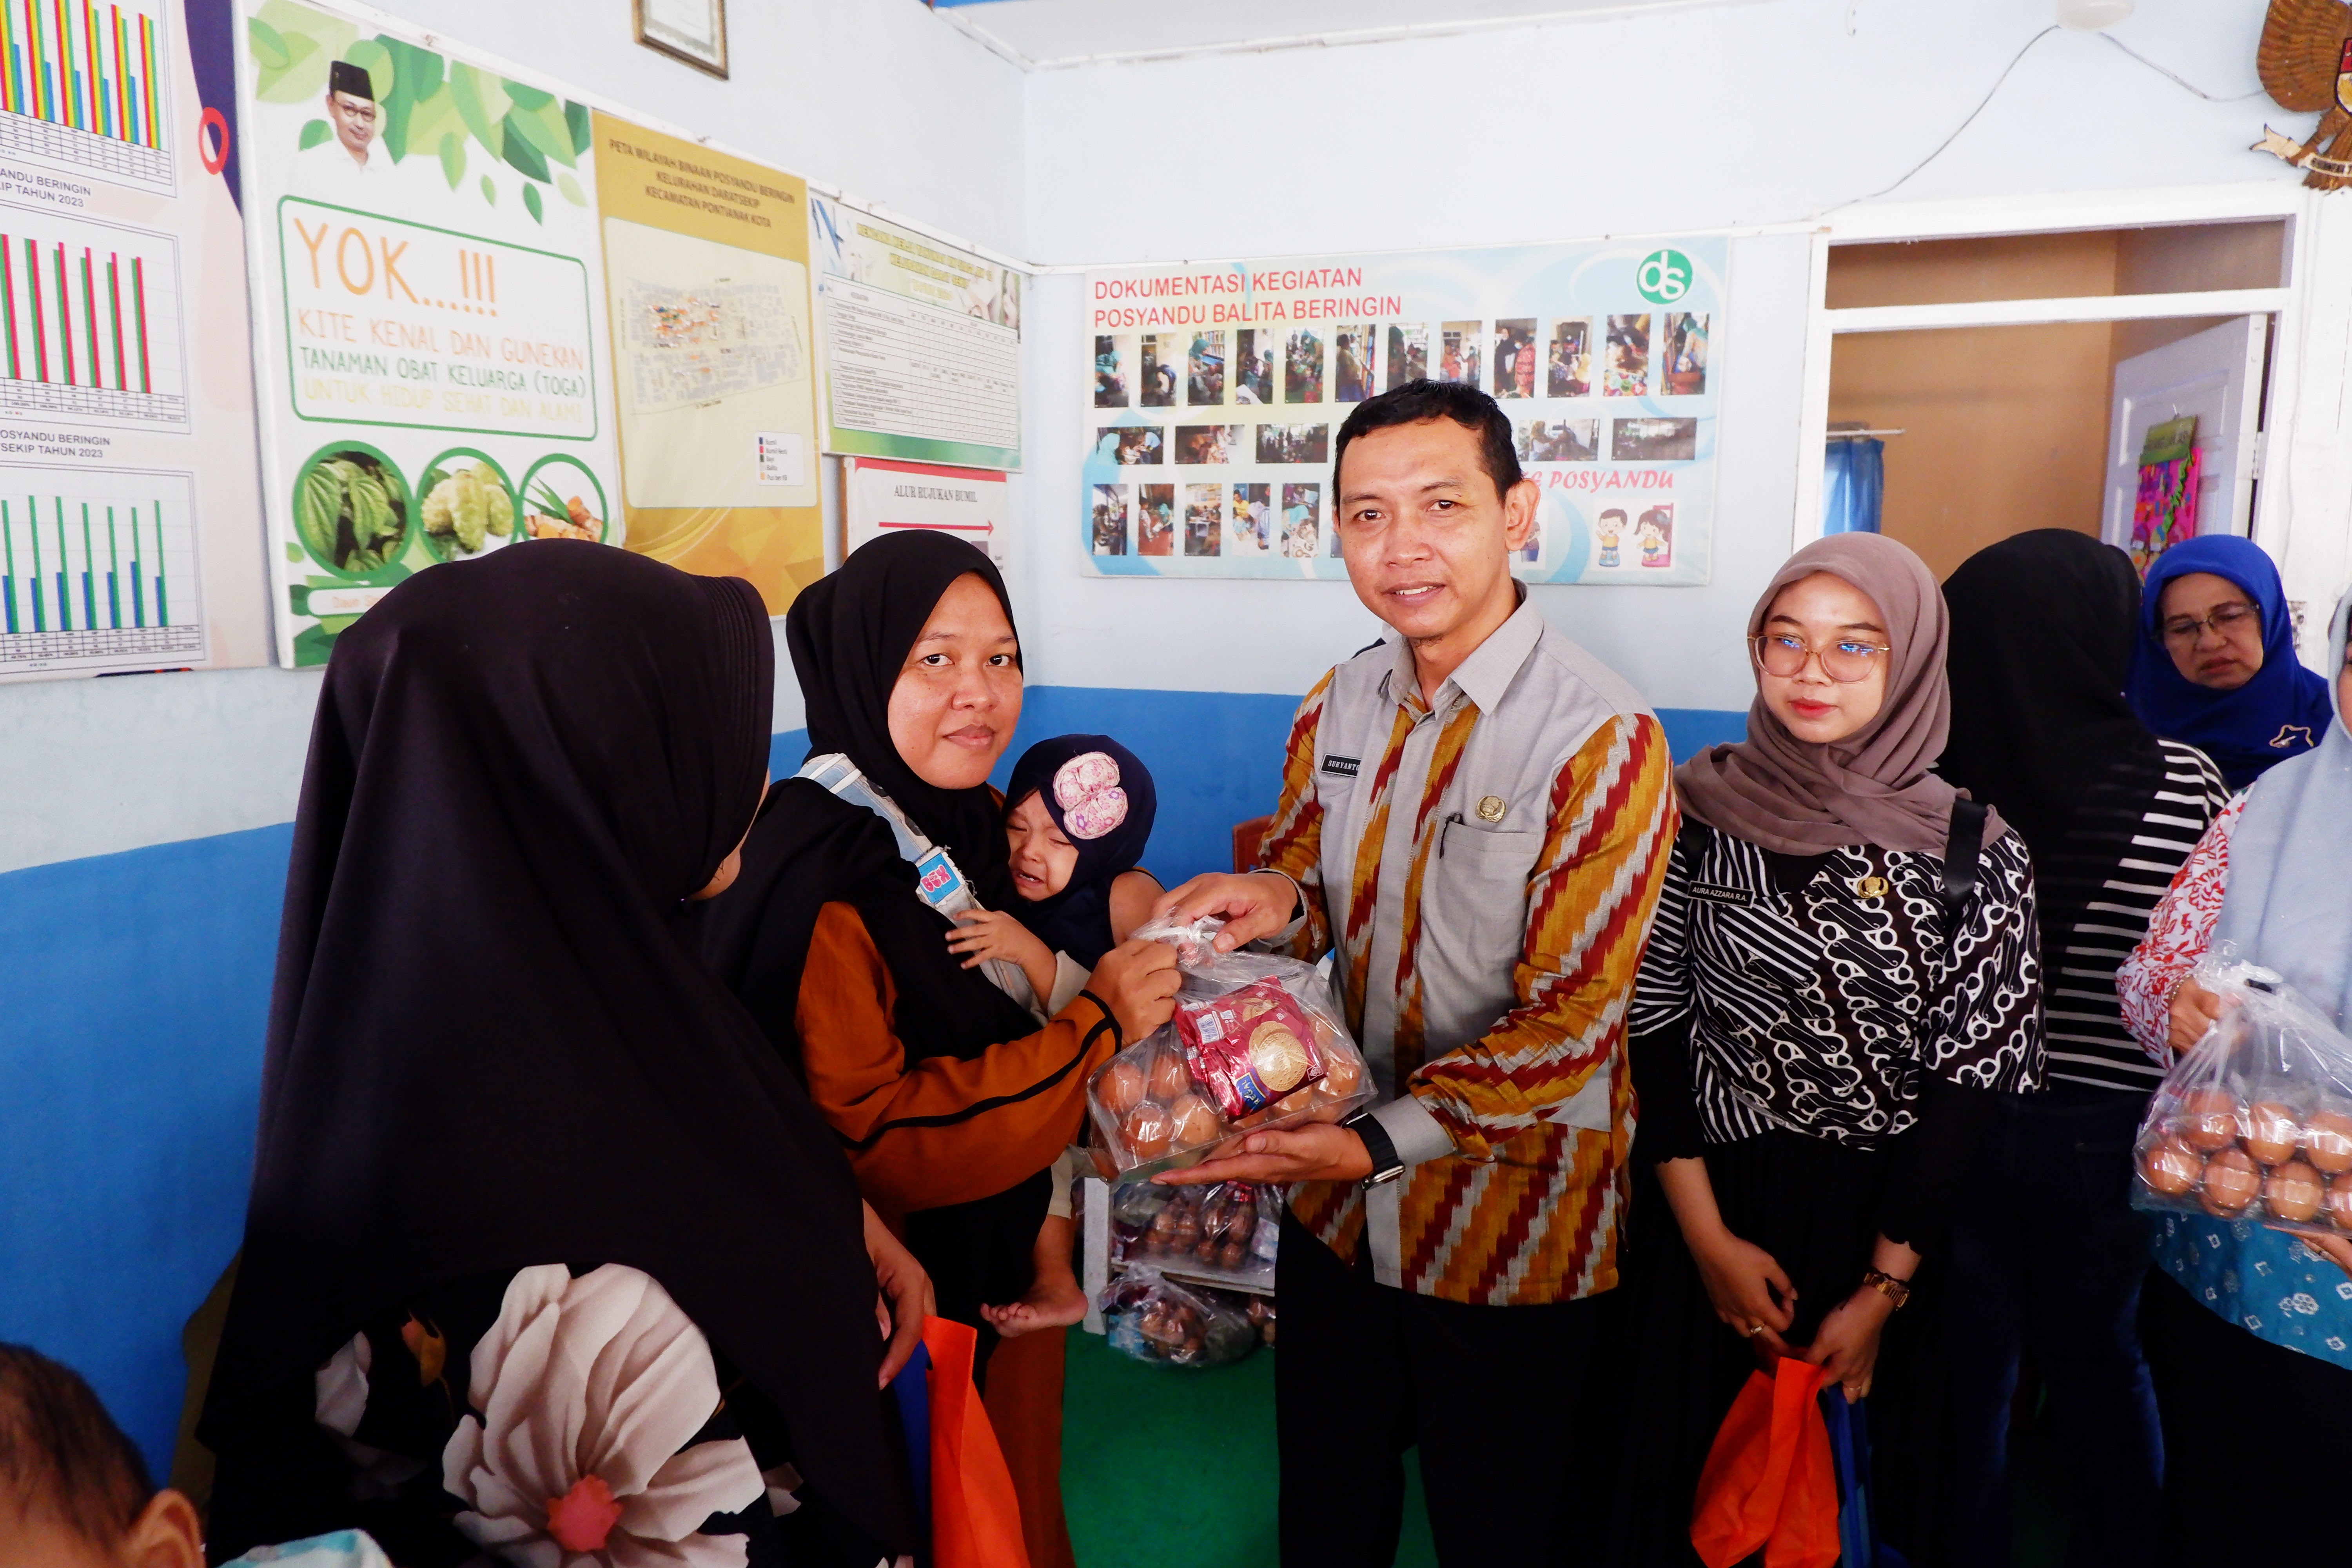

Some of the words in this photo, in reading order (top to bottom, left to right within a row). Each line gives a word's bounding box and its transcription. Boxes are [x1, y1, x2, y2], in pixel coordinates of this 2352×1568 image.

[15, 184, 55, 201] TAHUN
[59, 196, 84, 208] 2023
[37, 176, 91, 196] BERINGIN
[1095, 273, 1245, 301] DOKUMENTASI
[1252, 267, 1363, 293] KEGIATAN
[1094, 305, 1206, 328] POSYANDU
[1212, 301, 1287, 324] BALITA
[1293, 295, 1402, 319] BERINGIN
[298, 308, 357, 343] KITE
[370, 318, 440, 353] KENAL
[450, 330, 491, 359] DAN
[502, 337, 584, 371] GUNEKAN
[299, 346, 388, 377] TANAMAN
[397, 358, 438, 383] OBAT
[448, 363, 526, 393] KELUARGA
[534, 370, 587, 399] (TOGA)
[303, 378, 371, 405] UNTUK
[382, 384, 432, 410] HIDUP
[443, 391, 492, 414] SEHAT
[501, 397, 533, 417] DAN
[540, 400, 582, 423] ALAMI
[38, 445, 76, 456] TAHUN
[79, 448, 103, 458] 2023
[59, 434, 111, 446] BERINGIN
[894, 485, 916, 498] ALUR
[918, 486, 954, 500] RUJUKAN
[955, 490, 978, 502] BUMIL
[1548, 470, 1674, 493] POSYANDU
[1692, 886, 1709, 895] AURA
[1710, 890, 1735, 899] AZZARA
[1241, 1079, 1261, 1105] REGAL
